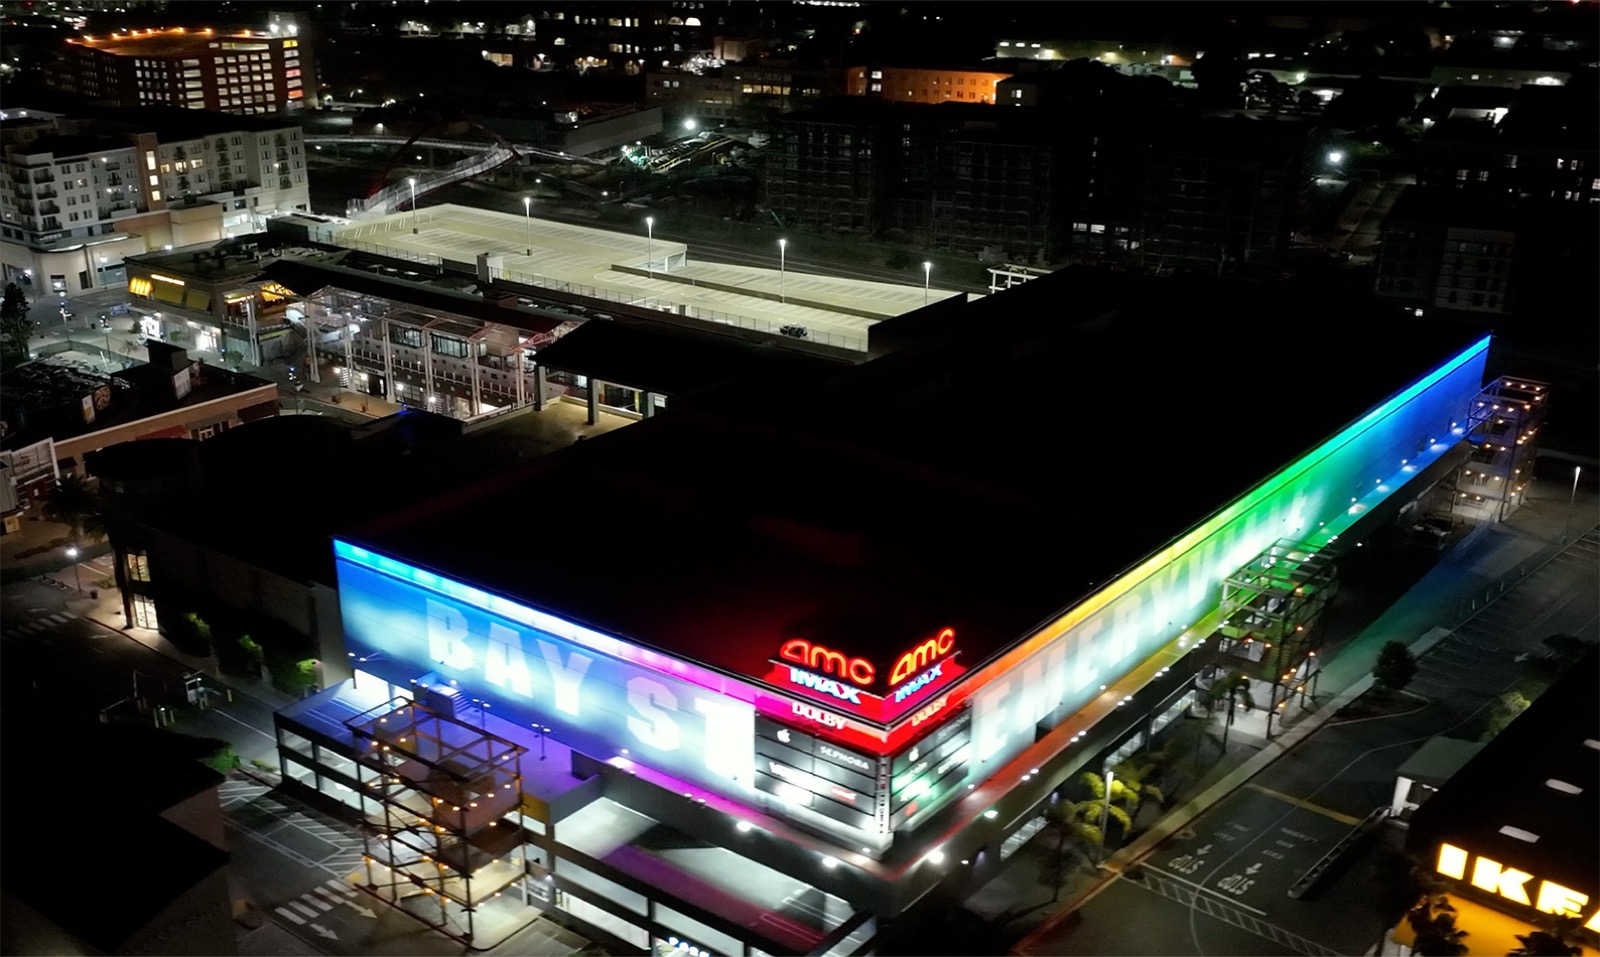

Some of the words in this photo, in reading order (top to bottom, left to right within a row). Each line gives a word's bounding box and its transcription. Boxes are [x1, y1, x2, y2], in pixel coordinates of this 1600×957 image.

[426, 597, 594, 717] BAY
[626, 675, 756, 783] ST
[789, 667, 862, 705] IMAX
[894, 664, 943, 703] IMAX
[791, 701, 848, 730] DOLBY
[820, 745, 870, 770] SEPHORA
[1167, 853, 1205, 875] STOP
[1217, 873, 1255, 896] STOP
[1436, 842, 1600, 934] IKE
